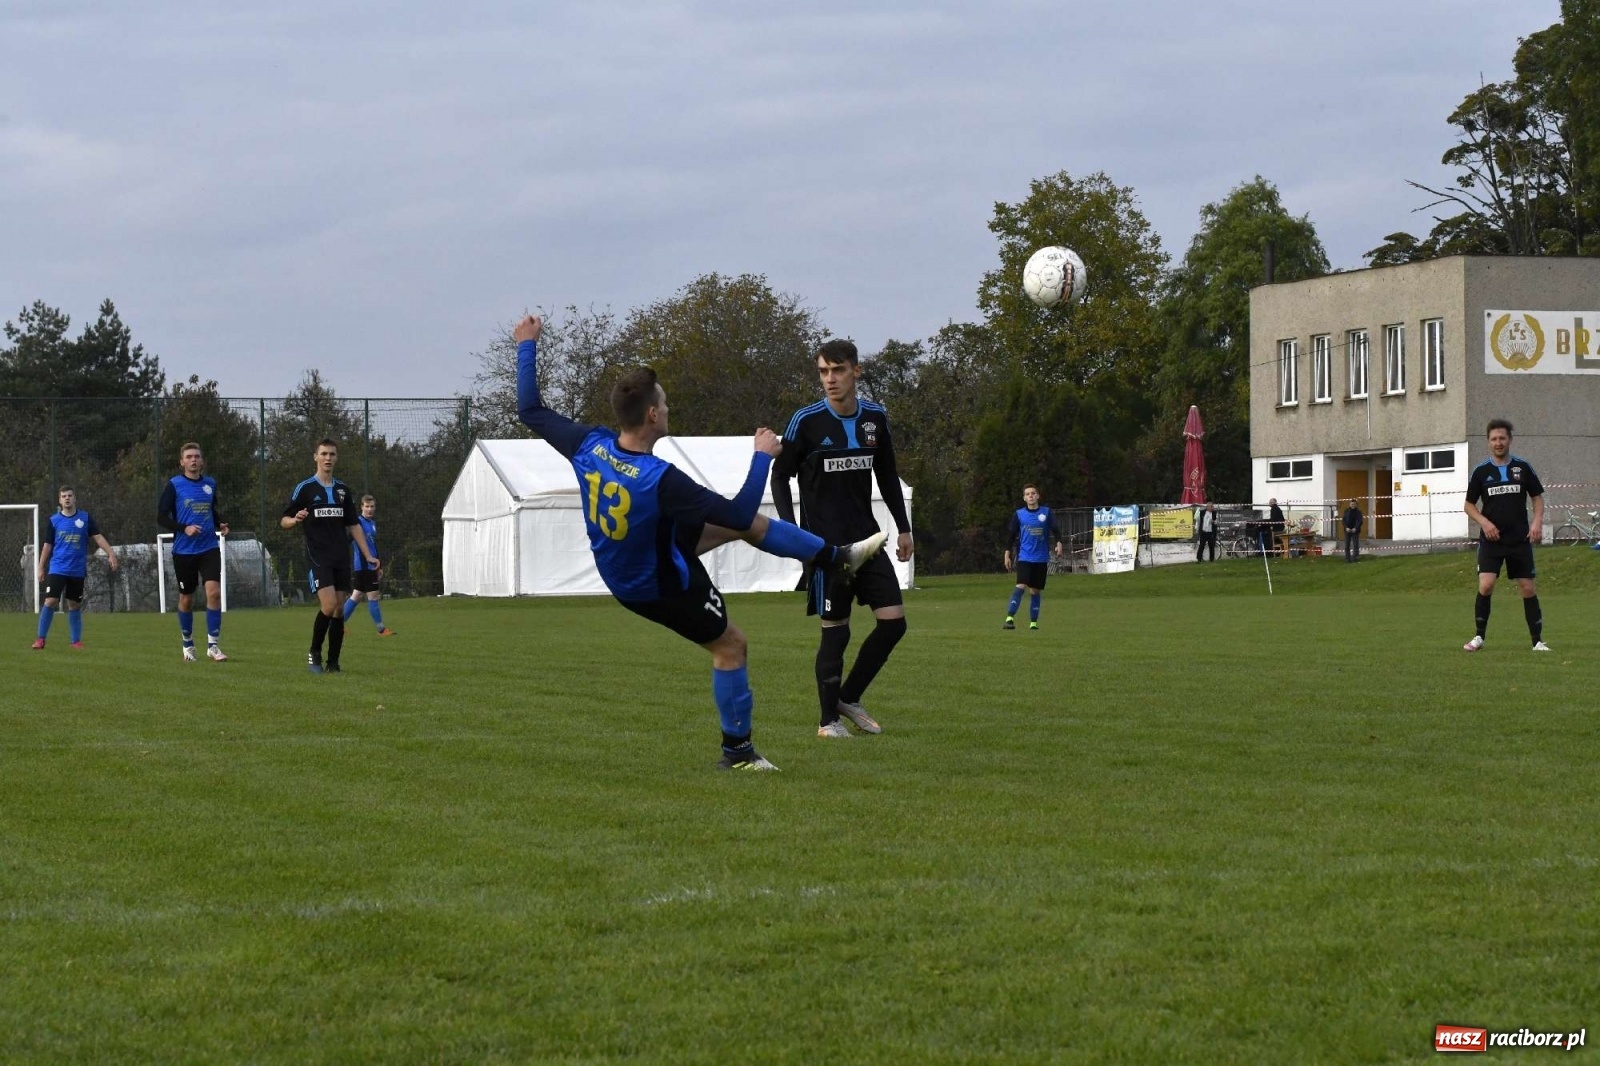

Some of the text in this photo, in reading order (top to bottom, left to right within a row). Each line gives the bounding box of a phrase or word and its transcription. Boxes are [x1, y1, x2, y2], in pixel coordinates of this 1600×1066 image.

[1556, 328, 1600, 355] BR
[827, 457, 873, 471] PROSAT
[1489, 485, 1519, 494] PROSAT
[317, 508, 344, 516] PROSAT
[584, 470, 632, 541] 13
